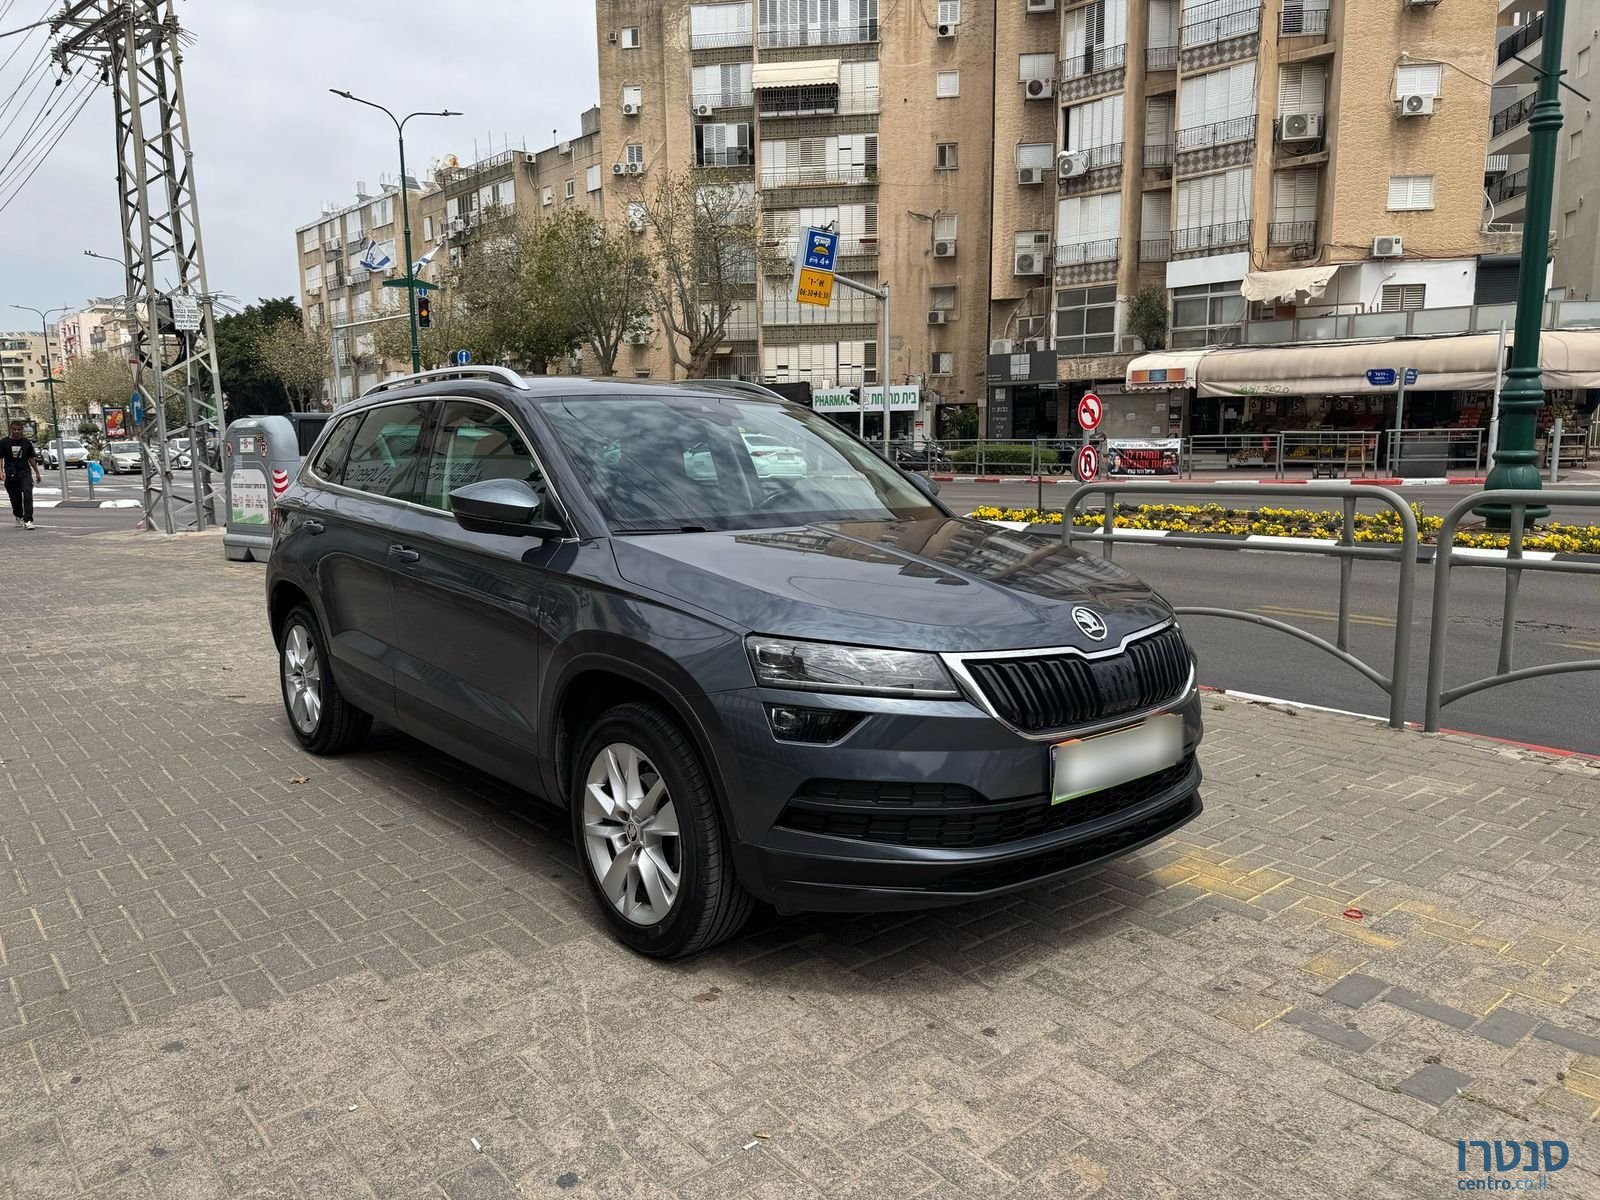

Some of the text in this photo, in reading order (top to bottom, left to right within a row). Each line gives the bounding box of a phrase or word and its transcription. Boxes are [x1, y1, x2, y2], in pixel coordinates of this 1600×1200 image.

[819, 257, 830, 266] 4+
[814, 394, 854, 407] PHARMAC
[870, 391, 917, 405] בית מרחת
